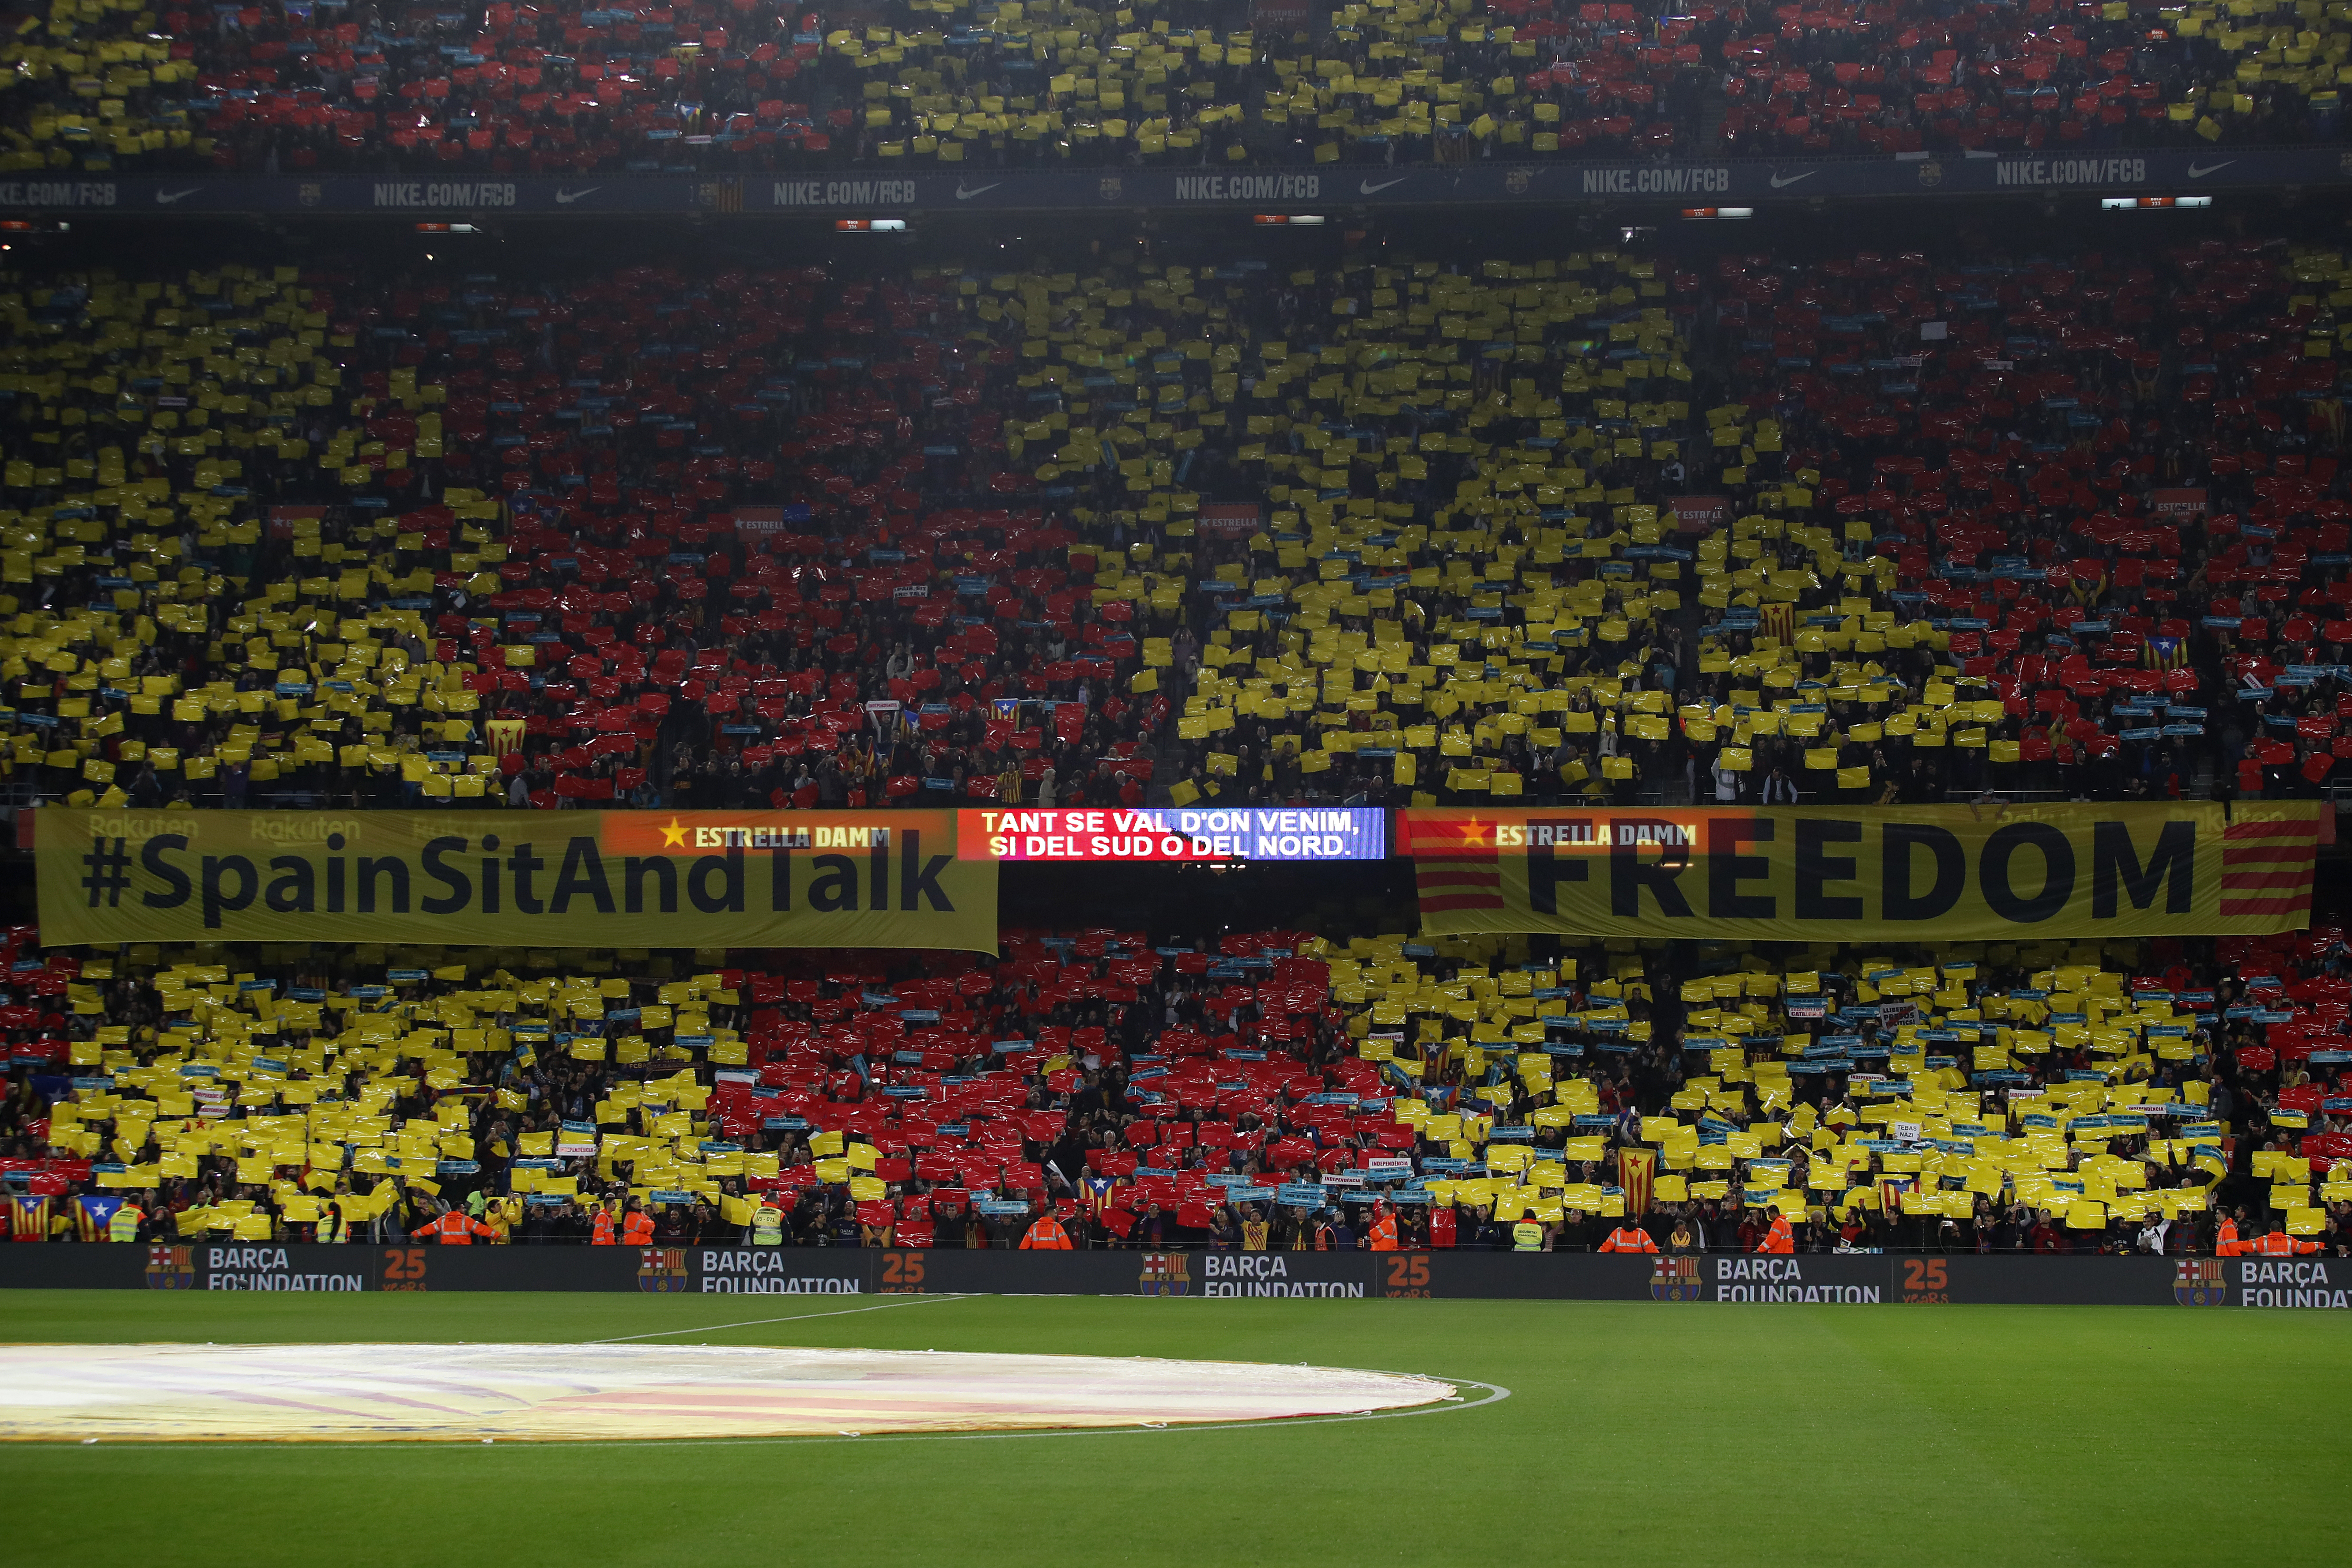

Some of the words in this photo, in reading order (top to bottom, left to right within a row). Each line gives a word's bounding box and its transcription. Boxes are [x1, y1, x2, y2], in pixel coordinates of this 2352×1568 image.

[1583, 169, 1729, 192] NIKE.COM/FCB
[1997, 159, 2145, 185] NIKE.COM/FCB
[375, 183, 516, 206] NIKE.COM/FCB
[774, 180, 915, 205] NIKE.COM/FCB
[1176, 175, 1319, 199] NIKE.COM/FCB
[981, 812, 1058, 832] TANT
[1065, 812, 1105, 832] SE
[1112, 812, 1172, 832] VAL
[1181, 812, 1250, 832] D'ON
[1258, 811, 1359, 835] VENIM,
[1495, 825, 1614, 846] ESTRELLA
[1618, 825, 1697, 846] DAMM
[695, 826, 811, 848] ESTRELLA
[815, 826, 891, 848] DAMM
[990, 836, 1016, 856] SI
[1026, 836, 1084, 856] DEL
[1091, 836, 1153, 856] SUD
[1160, 836, 1184, 856] O
[1193, 835, 1250, 856] DEL
[1259, 835, 1352, 856] NORD.
[82, 829, 955, 928] #SpainSitAndTalk
[1527, 818, 2196, 923] FREEDOM
[208, 1248, 290, 1272] BARÇA
[384, 1249, 426, 1279] 25
[702, 1251, 784, 1276] BARÇA
[883, 1253, 925, 1283] 25
[1205, 1256, 1287, 1281] BARÇA
[1387, 1255, 1431, 1287] 25
[1717, 1259, 1801, 1284] BARÇA
[1903, 1258, 1948, 1290] 25
[2241, 1262, 2329, 1288] BARÇA
